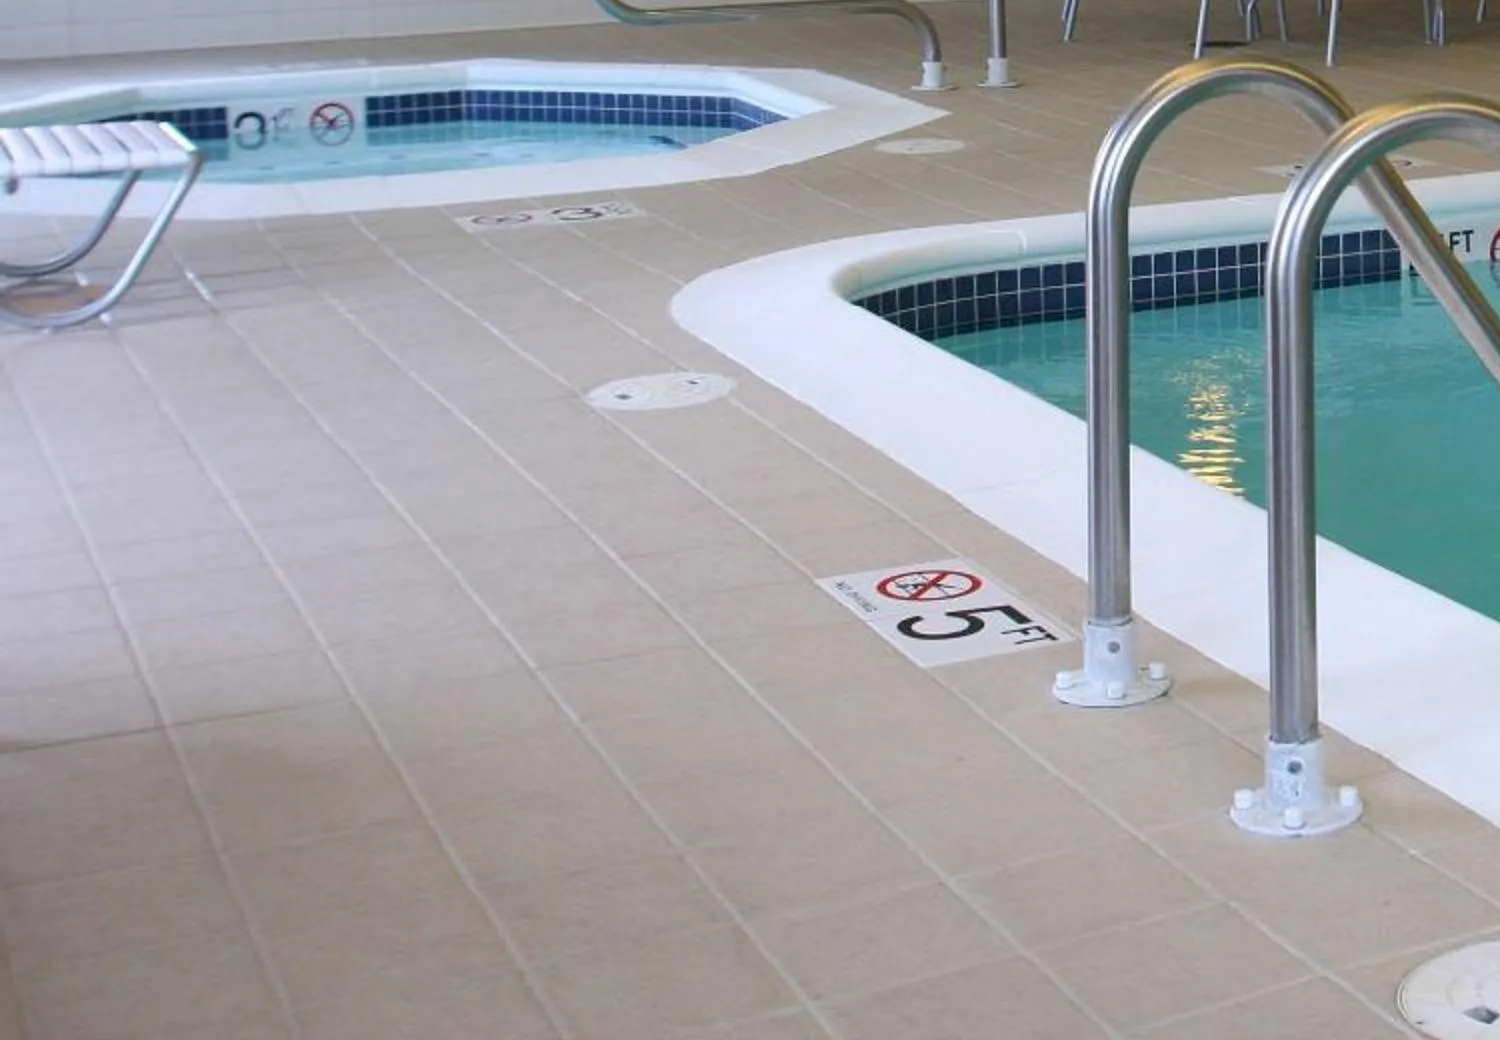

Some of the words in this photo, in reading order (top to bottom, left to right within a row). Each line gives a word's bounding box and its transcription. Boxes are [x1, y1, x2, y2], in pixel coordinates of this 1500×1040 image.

[1449, 230, 1474, 253] FT
[896, 604, 1034, 642] 5
[1000, 624, 1060, 645] FT
